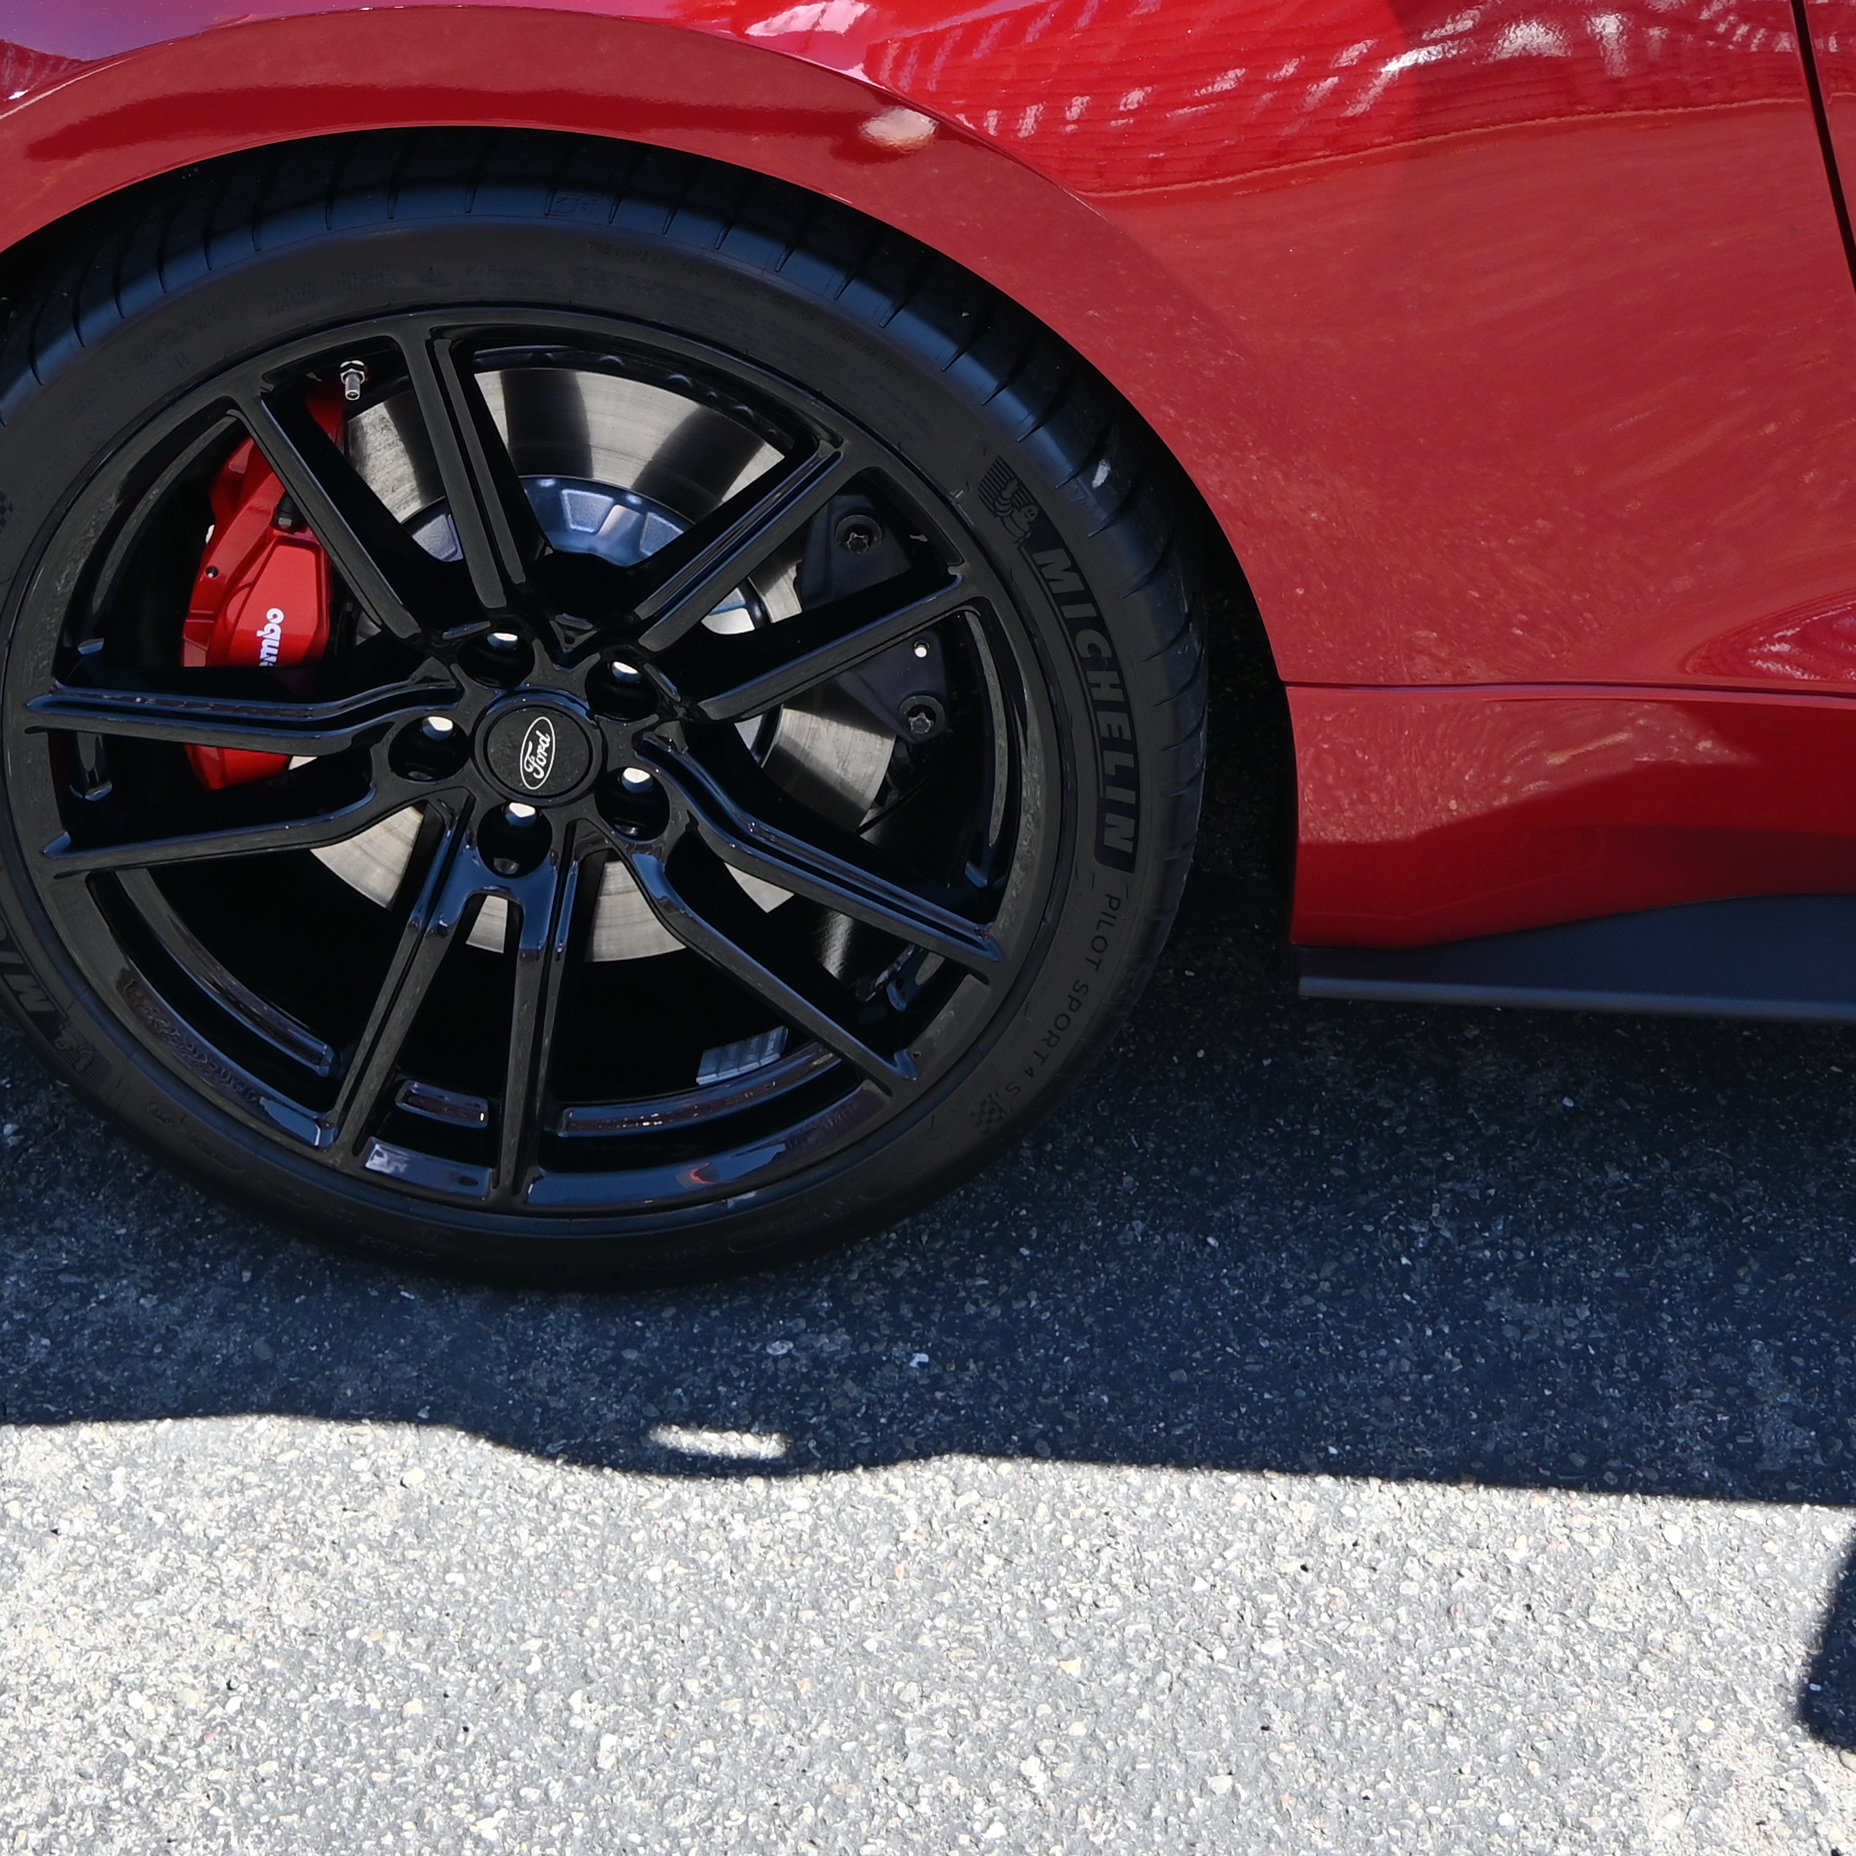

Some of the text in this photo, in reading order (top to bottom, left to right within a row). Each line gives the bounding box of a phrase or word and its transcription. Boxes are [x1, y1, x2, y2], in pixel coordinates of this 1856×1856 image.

[1033, 546, 1137, 853] MICHELIN
[524, 730, 550, 779] Ford
[1084, 893, 1122, 972] PILOT
[1033, 980, 1089, 1065] SPORT
[1006, 1082, 1021, 1093] S
